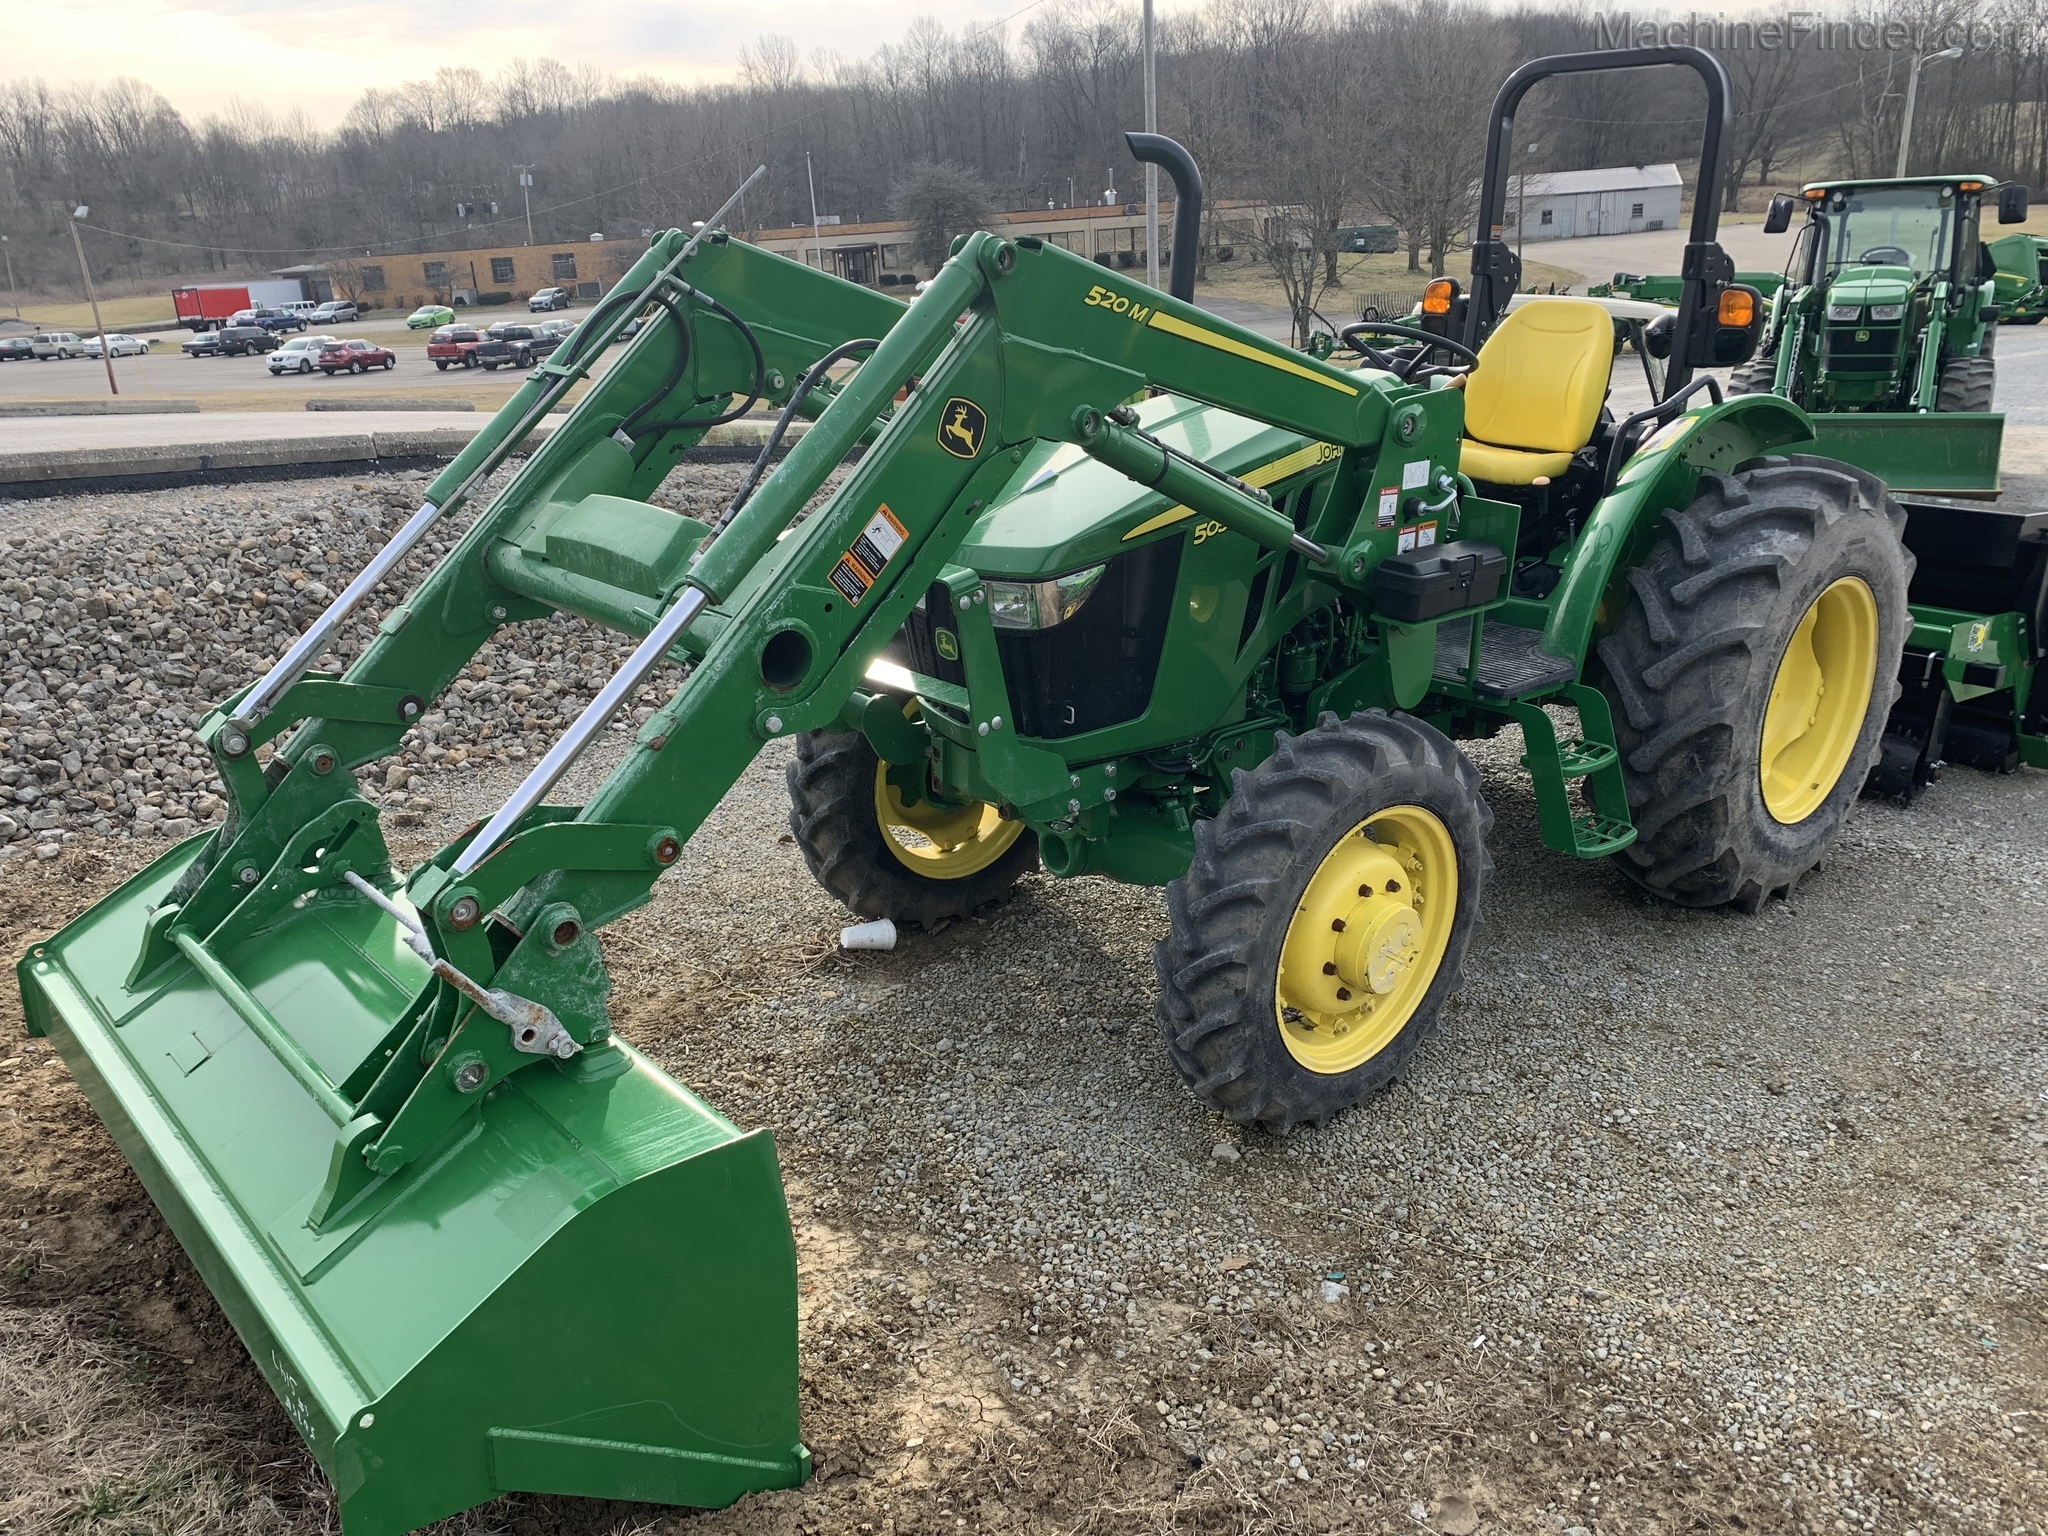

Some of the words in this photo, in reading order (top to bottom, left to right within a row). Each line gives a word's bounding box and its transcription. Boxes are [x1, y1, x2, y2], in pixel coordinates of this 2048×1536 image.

[1083, 285, 1130, 313] 520
[1127, 302, 1150, 323] M
[1316, 443, 1344, 465] JOH
[887, 514, 905, 535] WARNING
[851, 562, 870, 584] WARNING
